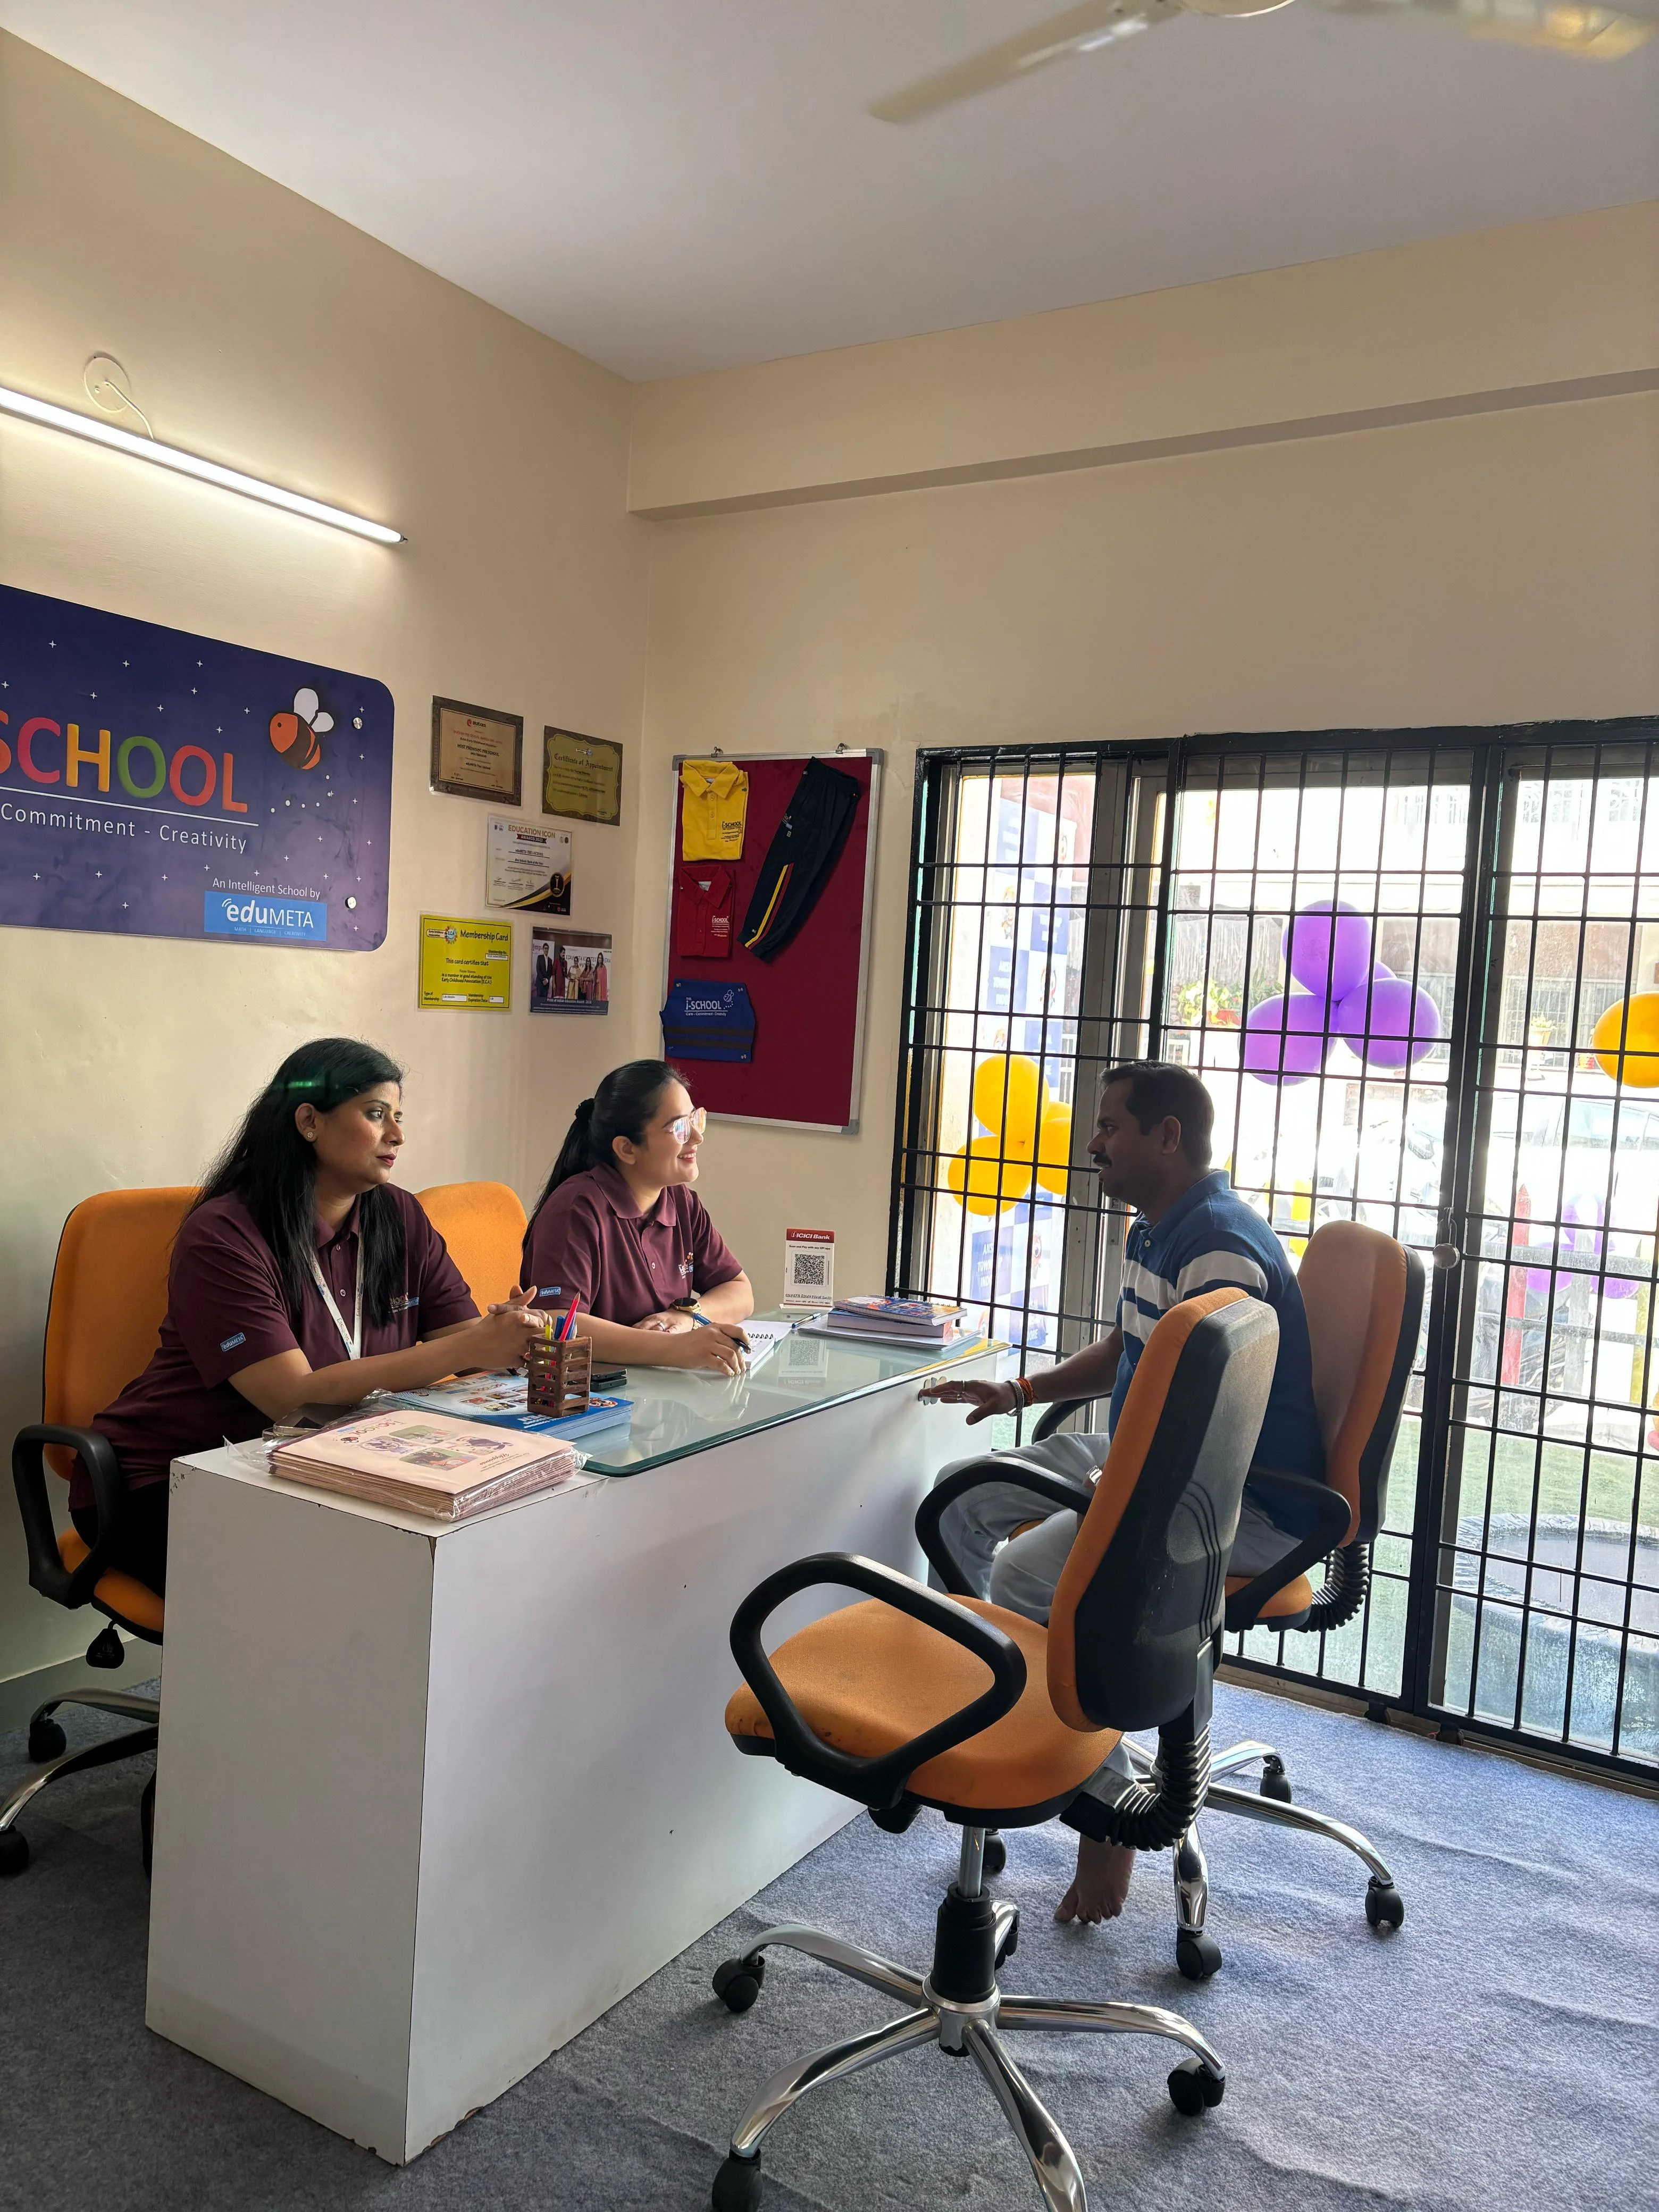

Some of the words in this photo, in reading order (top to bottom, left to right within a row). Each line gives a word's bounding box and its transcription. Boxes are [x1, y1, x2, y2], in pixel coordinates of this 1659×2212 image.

[554, 753, 577, 764] Certificate
[585, 759, 613, 772] Appointment
[1, 803, 136, 836] Commitment
[160, 825, 247, 853] Creativity
[508, 825, 541, 836] EDUCATION
[213, 878, 225, 889] An
[229, 879, 275, 894] Intelligent
[278, 884, 307, 897] School
[310, 887, 320, 901] by
[226, 900, 314, 928] eduMETA
[460, 929, 495, 943] Membership
[496, 933, 508, 941] Card
[685, 1000, 722, 1010] i-SCHOOL
